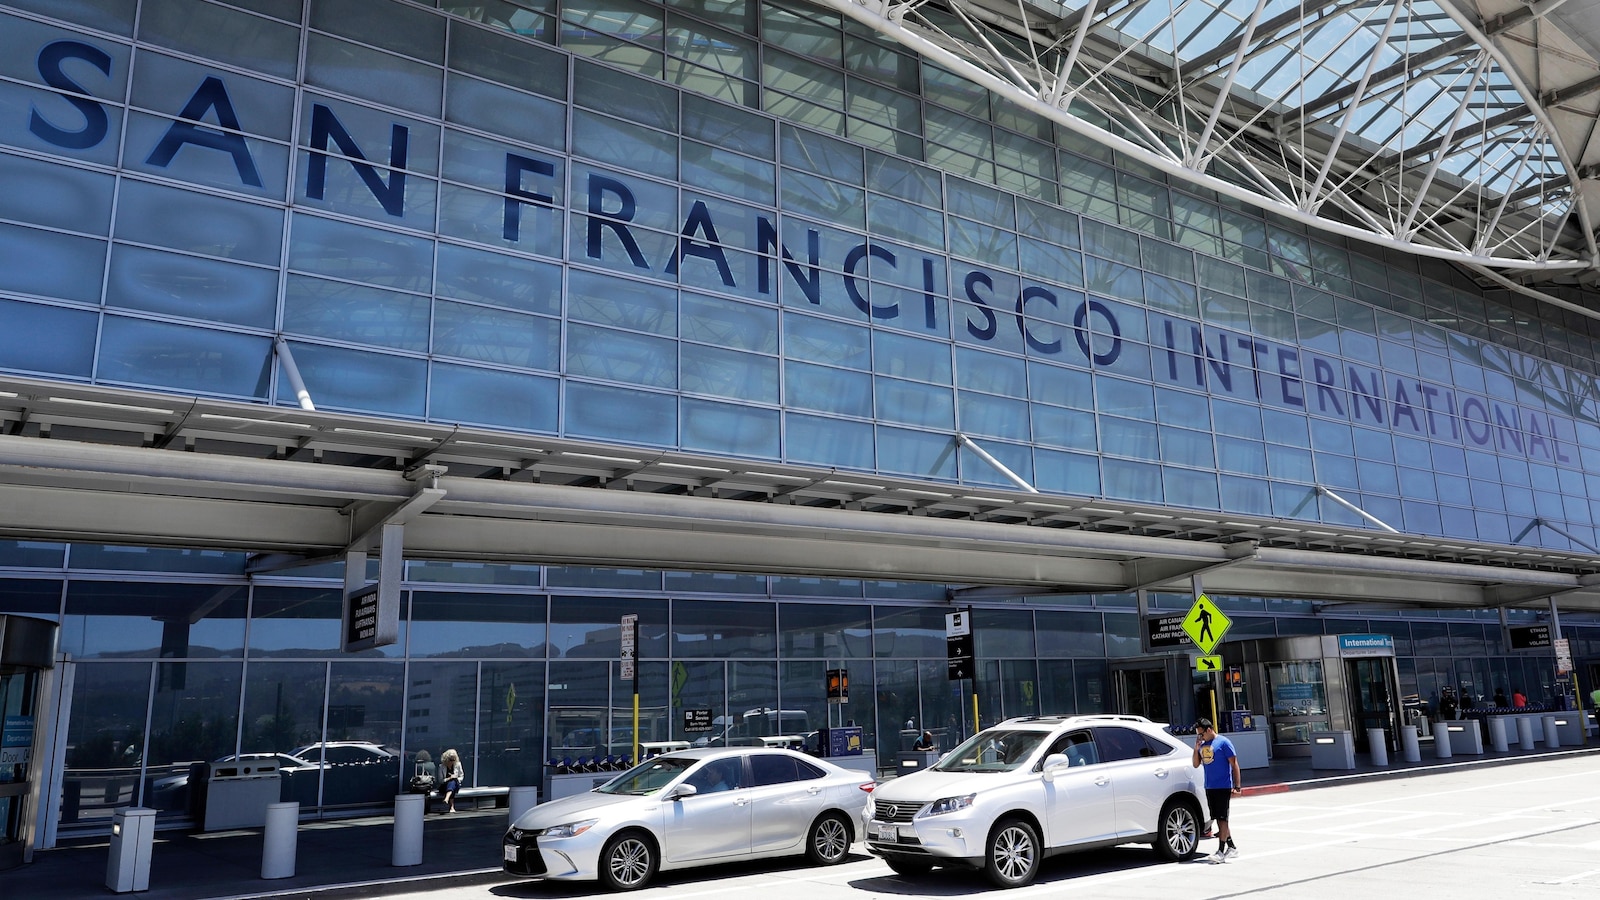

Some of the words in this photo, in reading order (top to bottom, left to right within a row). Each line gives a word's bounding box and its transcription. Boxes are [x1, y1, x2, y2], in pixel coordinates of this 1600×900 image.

[28, 39, 410, 219] SAN
[502, 152, 1122, 367] FRANCISCO
[1163, 318, 1570, 464] INTERNATIONAL
[1152, 632, 1170, 640] CATHAY
[1344, 638, 1384, 647] International
[2, 752, 18, 762] Door
